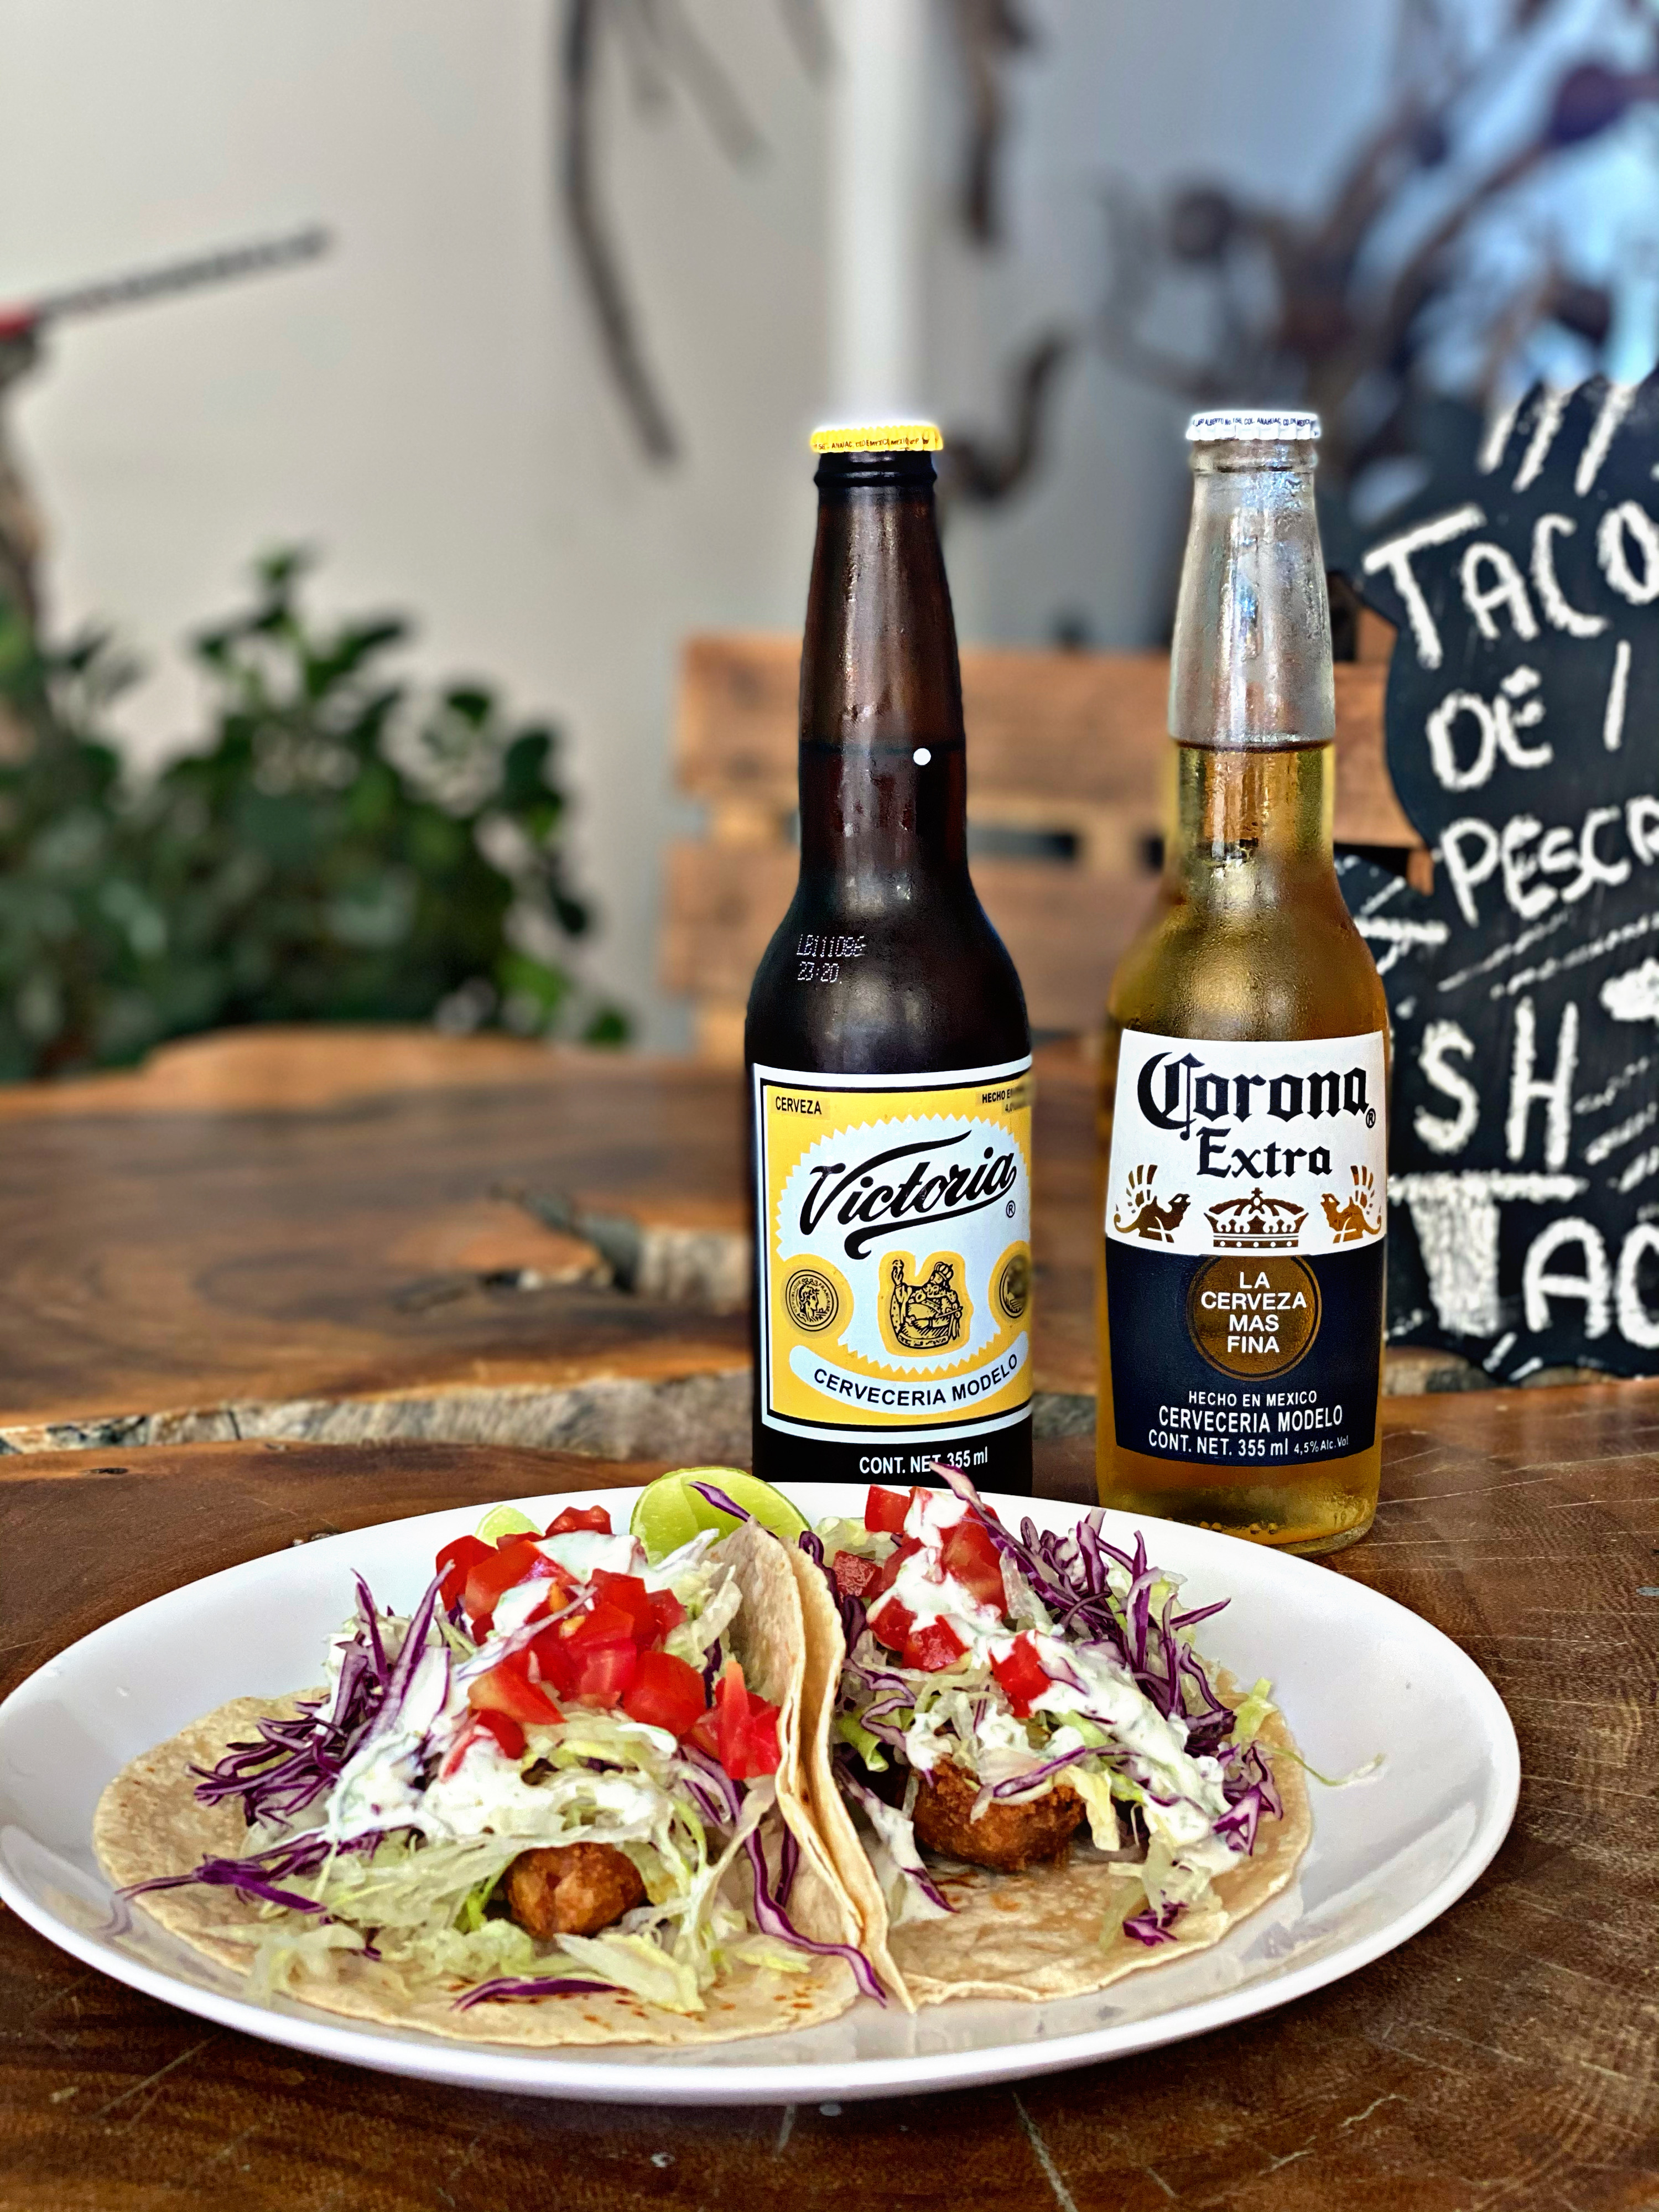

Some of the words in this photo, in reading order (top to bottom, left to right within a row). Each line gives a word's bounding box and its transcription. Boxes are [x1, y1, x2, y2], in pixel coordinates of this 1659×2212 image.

[1426, 664, 1553, 792] DE
[776, 1095, 822, 1115] CERVEZA
[982, 1090, 1006, 1104] HECHO
[1137, 1052, 1370, 1141] Corona
[1195, 1126, 1333, 1179] Extra
[799, 1130, 1017, 1260] Victoria
[1239, 1271, 1270, 1289] LA
[1200, 1291, 1307, 1310] CERVEZA
[1229, 1314, 1280, 1332] MAS
[1227, 1335, 1280, 1354] FINA
[814, 1368, 946, 1407] CERVECERIA
[952, 1354, 1018, 1402] MODELO
[1188, 1390, 1237, 1407] HECHO
[1242, 1393, 1261, 1407] EN
[1266, 1390, 1317, 1406] MEXICO
[1159, 1405, 1271, 1434] CERVECERIA
[1277, 1404, 1343, 1432] MODELO
[1148, 1429, 1192, 1453] CONT.
[1197, 1438, 1232, 1456] NET.
[1238, 1438, 1266, 1457] 355
[1270, 1437, 1289, 1456] ml
[1293, 1440, 1319, 1456] 4,5%
[859, 1456, 906, 1474] CONT.
[946, 1450, 971, 1468] 355
[974, 1446, 988, 1466] ml
